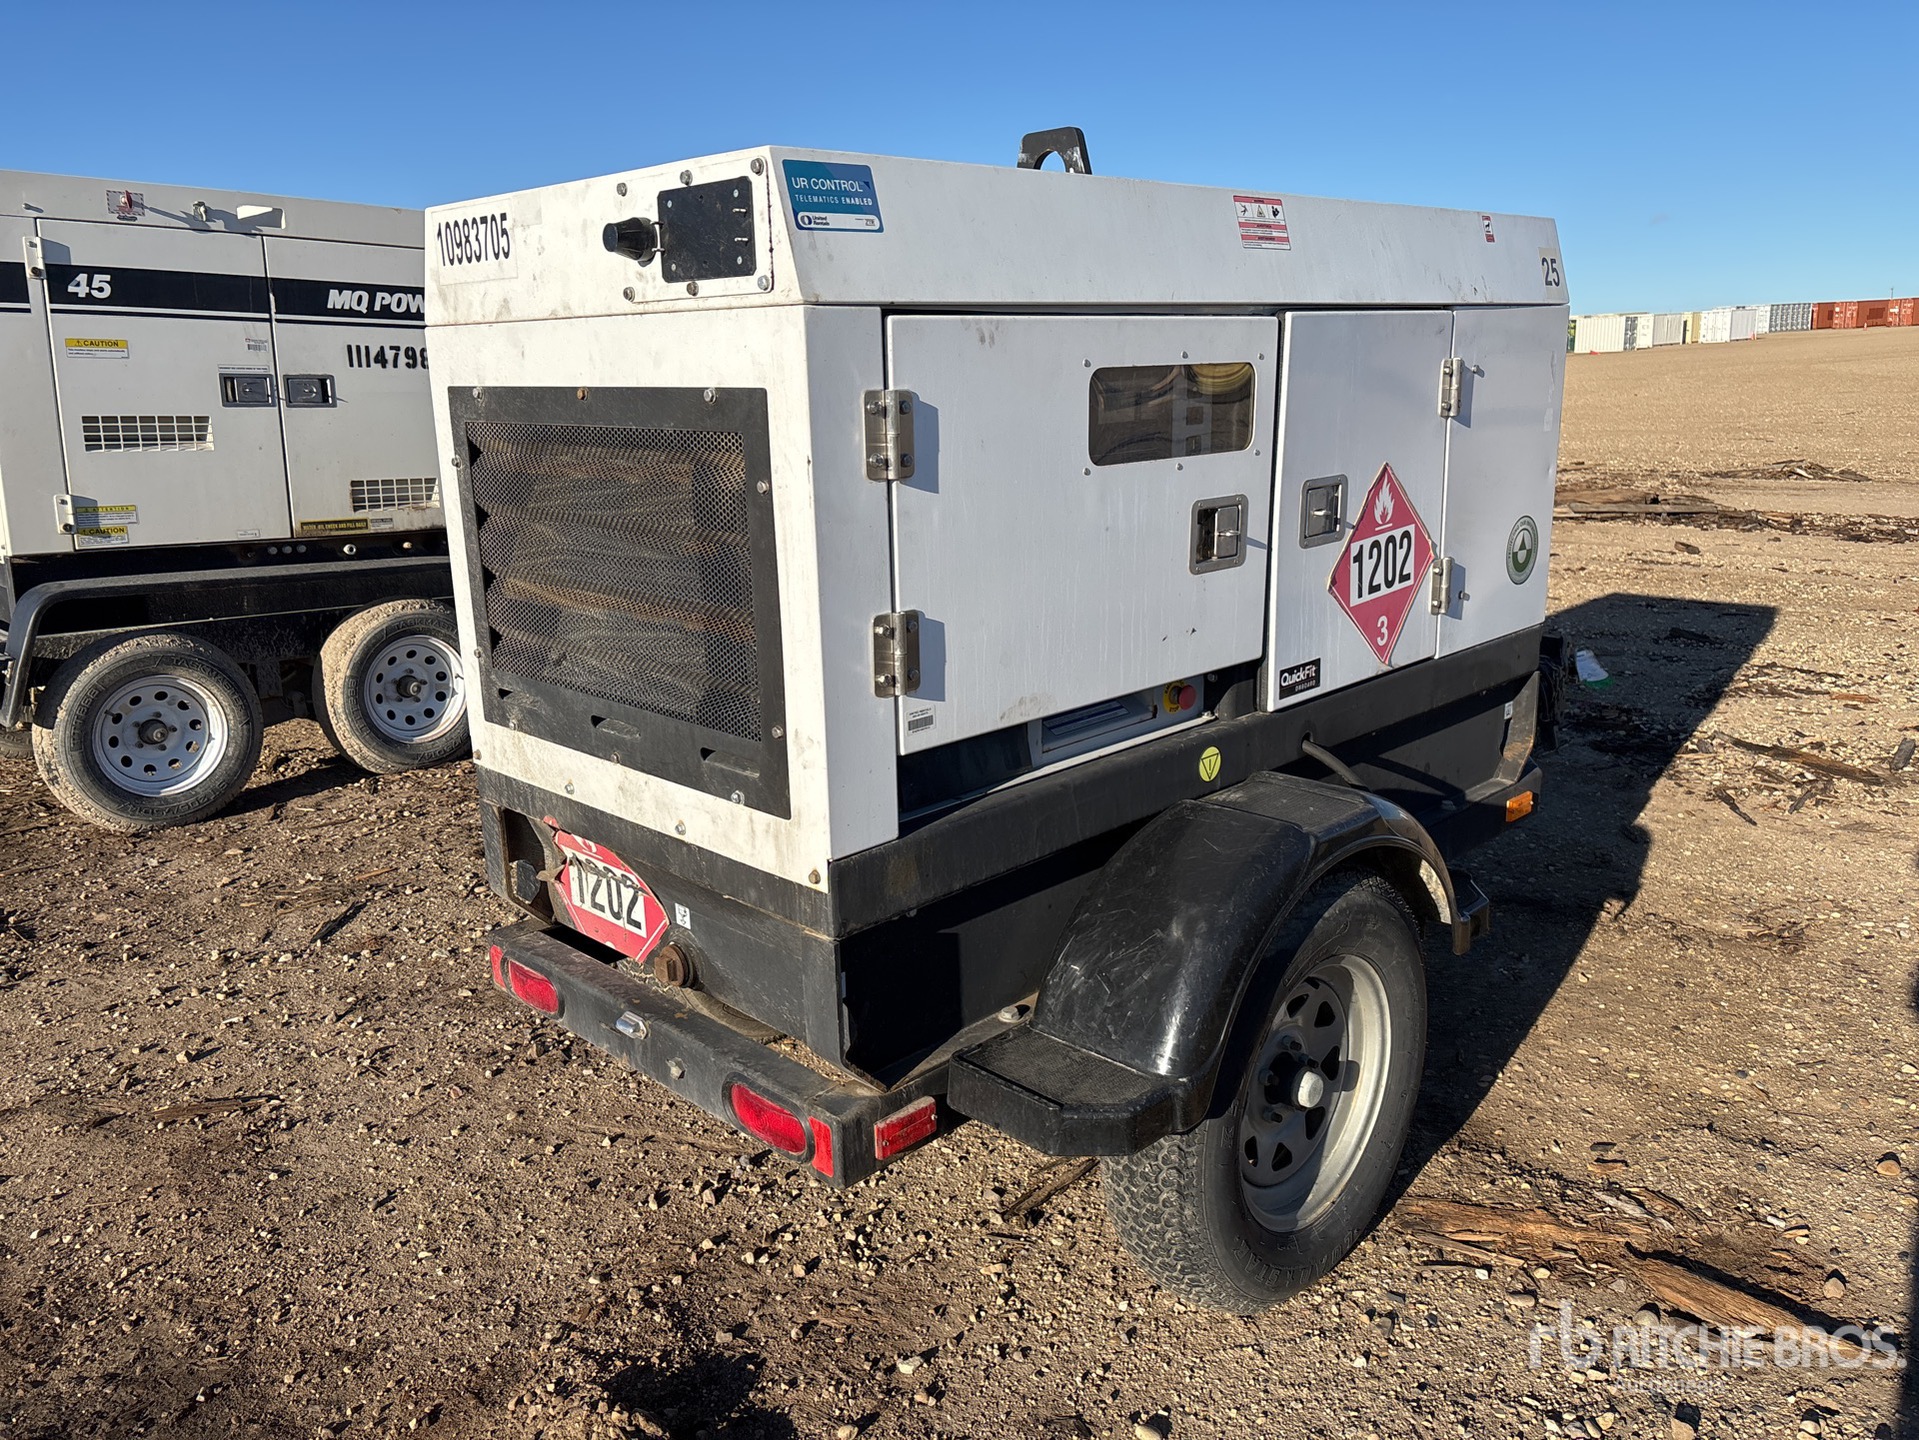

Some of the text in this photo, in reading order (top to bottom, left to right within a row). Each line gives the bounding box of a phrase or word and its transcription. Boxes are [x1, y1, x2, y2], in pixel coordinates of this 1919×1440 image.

[791, 176, 864, 193] UR CONTROL
[794, 194, 873, 206] TELEMATICS ENABLED
[437, 212, 512, 268] 10983705
[1541, 257, 1561, 288] 25
[67, 273, 112, 300] 45
[327, 289, 370, 314] MQ
[83, 339, 120, 348] CAUTION
[88, 527, 125, 536] CAUTION
[1352, 528, 1414, 600] 1202
[1376, 615, 1389, 648] 3
[1280, 664, 1317, 687] QuickFit
[571, 852, 643, 931] 1202
